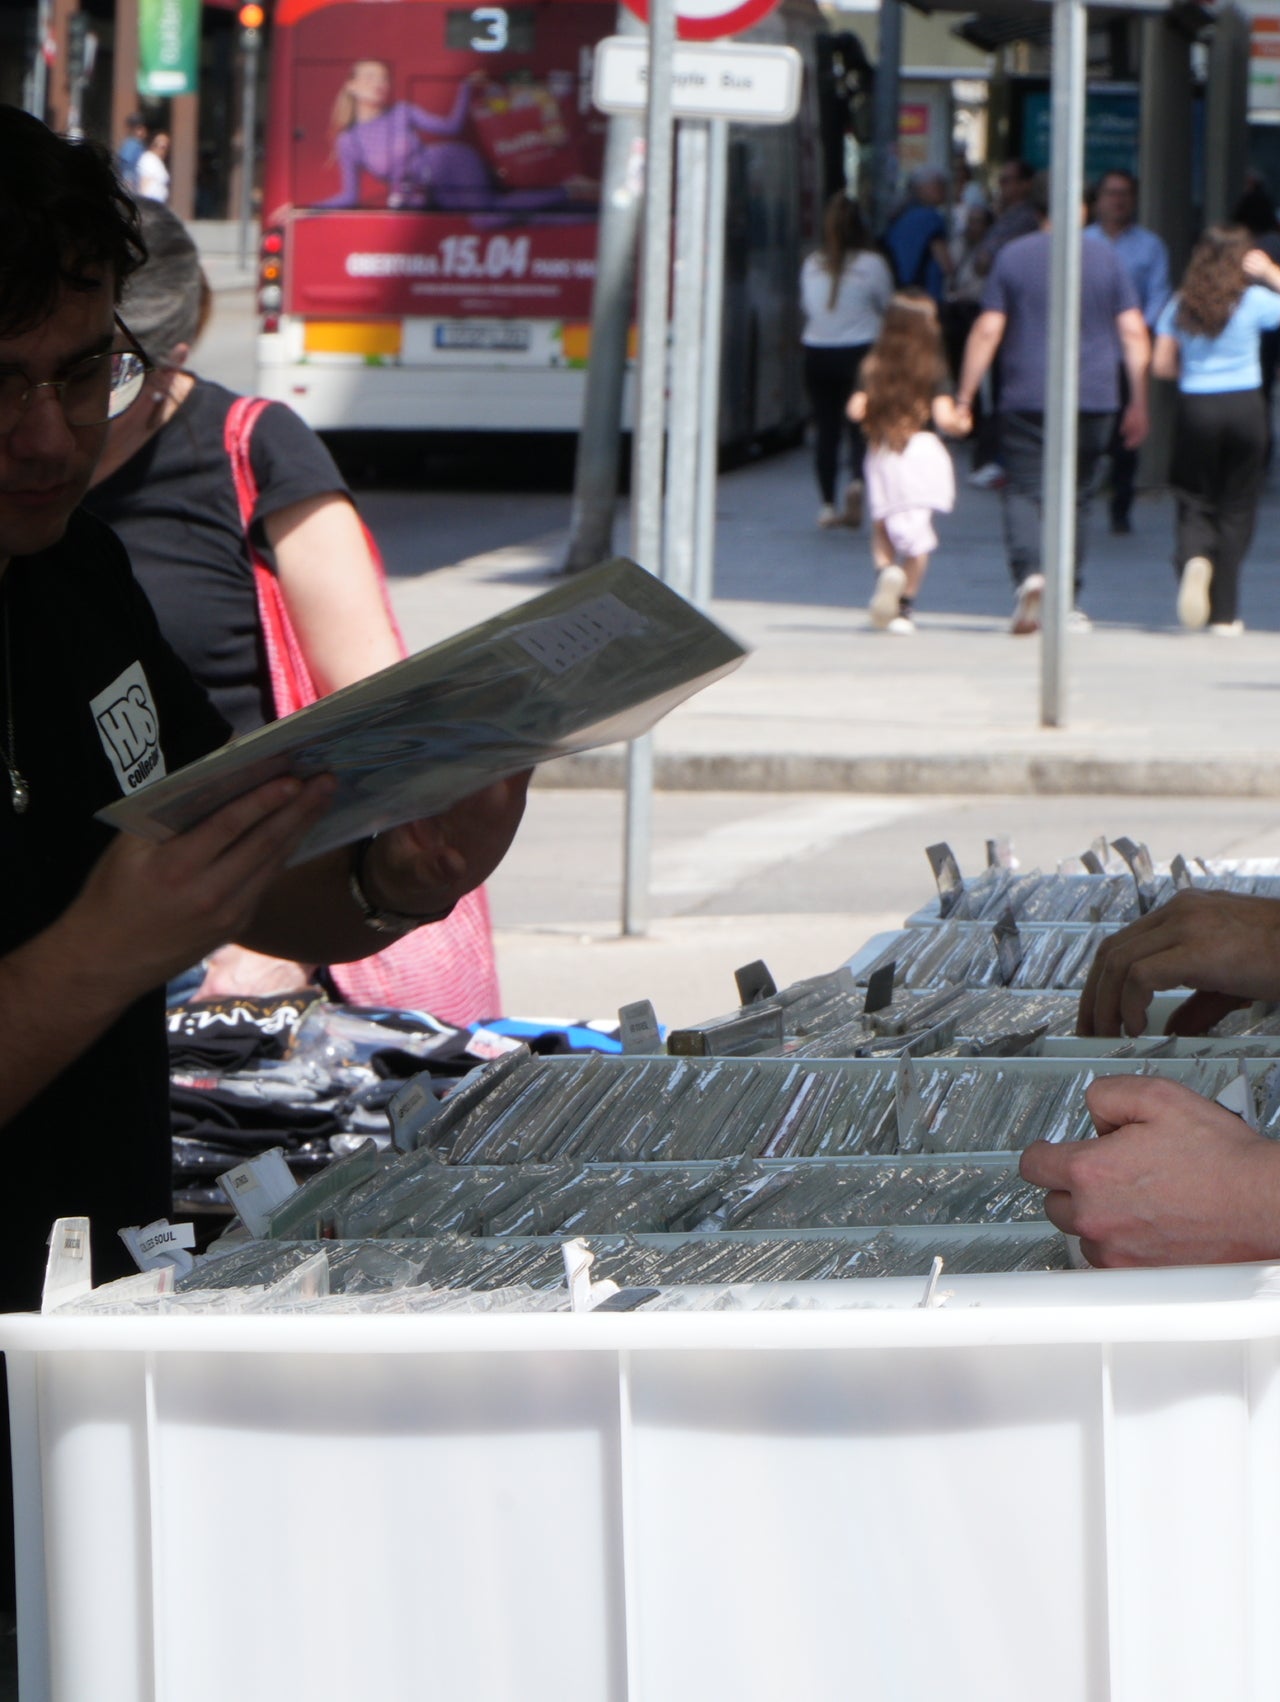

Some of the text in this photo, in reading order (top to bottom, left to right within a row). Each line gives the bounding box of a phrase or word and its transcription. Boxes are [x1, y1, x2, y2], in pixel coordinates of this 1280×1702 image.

[470, 7, 508, 51] 3
[439, 235, 531, 277] 15.04
[97, 684, 157, 772] HDS
[154, 1231, 176, 1245] SOUL
